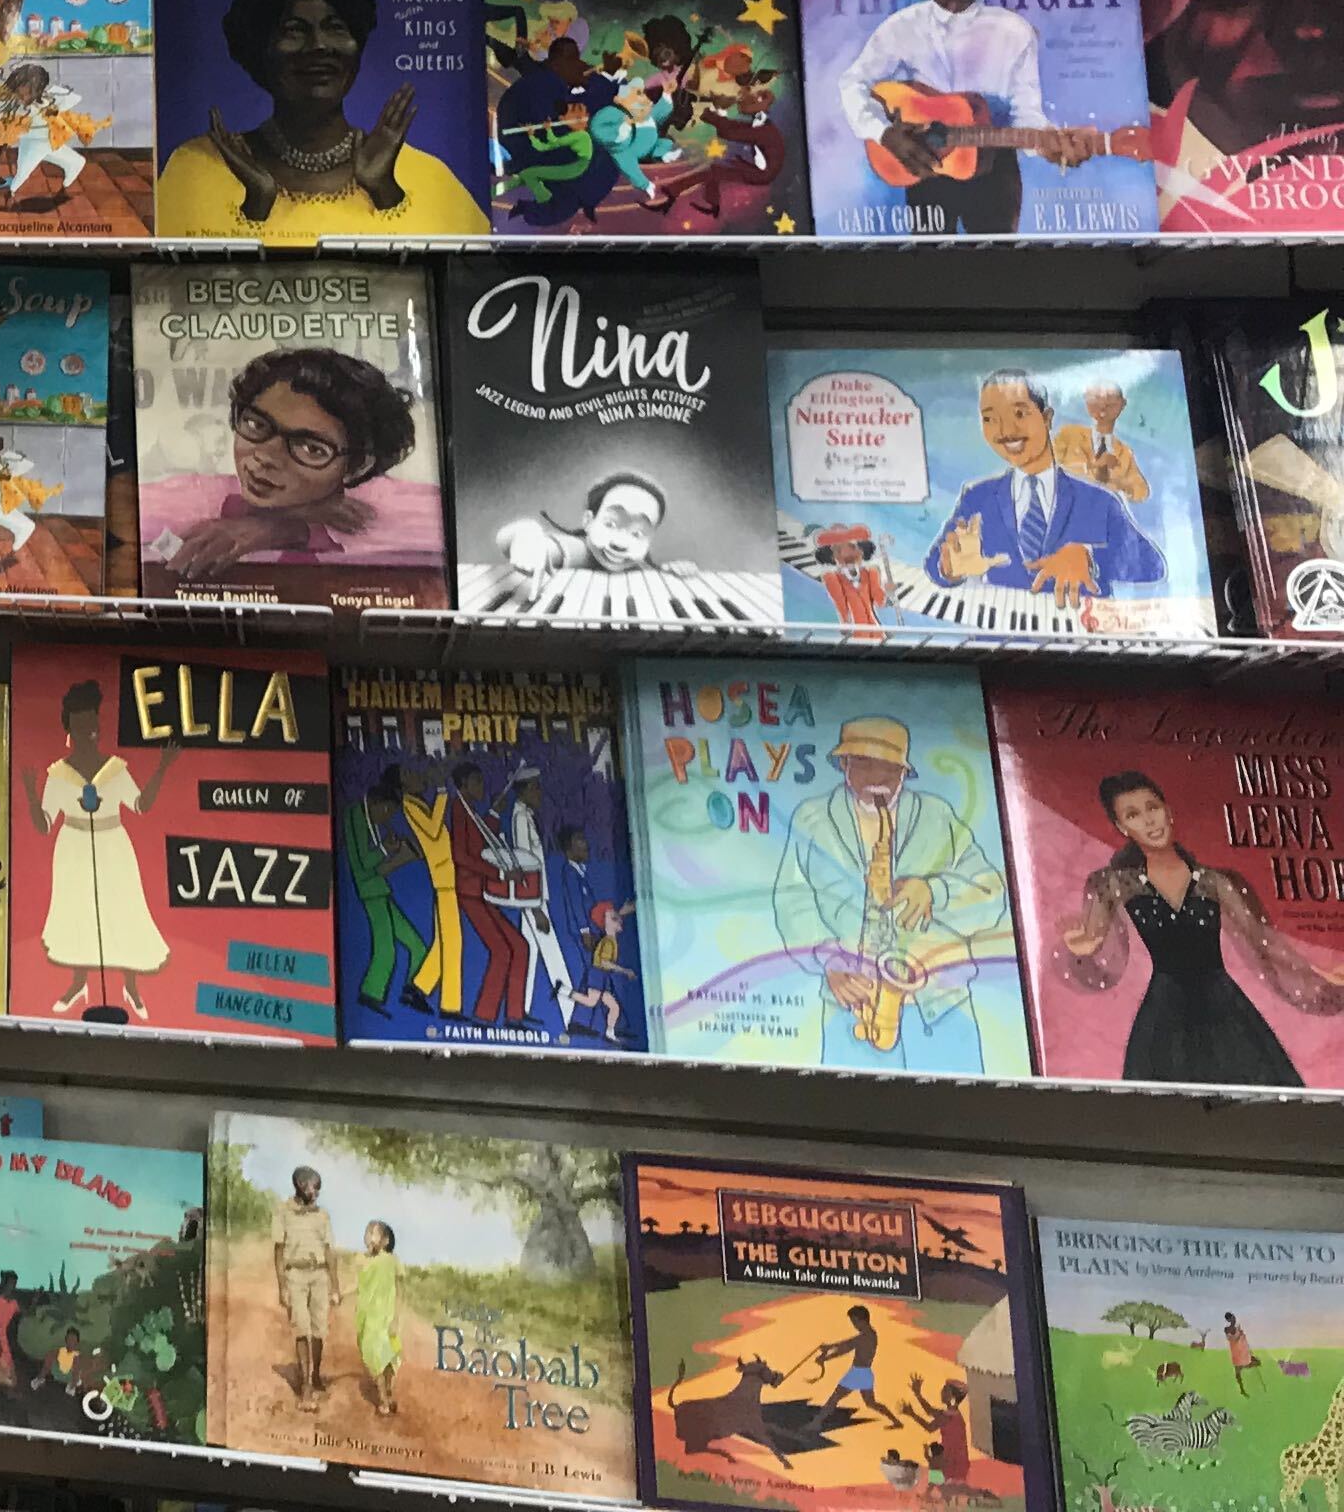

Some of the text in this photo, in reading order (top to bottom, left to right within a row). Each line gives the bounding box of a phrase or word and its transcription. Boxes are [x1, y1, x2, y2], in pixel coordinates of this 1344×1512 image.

[187, 278, 370, 304] BECAUSE
[160, 313, 400, 340] CLAUDETTE
[467, 275, 711, 393] Nina
[133, 663, 298, 742] ELLA
[660, 681, 816, 727] HOSEA
[664, 735, 816, 783] PLAYS
[212, 787, 304, 806] QUEEN OF
[707, 792, 770, 834] ON
[1224, 802, 1332, 851] LENA
[177, 843, 310, 903] JAZZ
[732, 1199, 904, 1237] SEBGUGUGU
[733, 1240, 907, 1276] THE GLUTTON
[434, 1325, 600, 1389] Baobab
[494, 1385, 591, 1435] Tree
